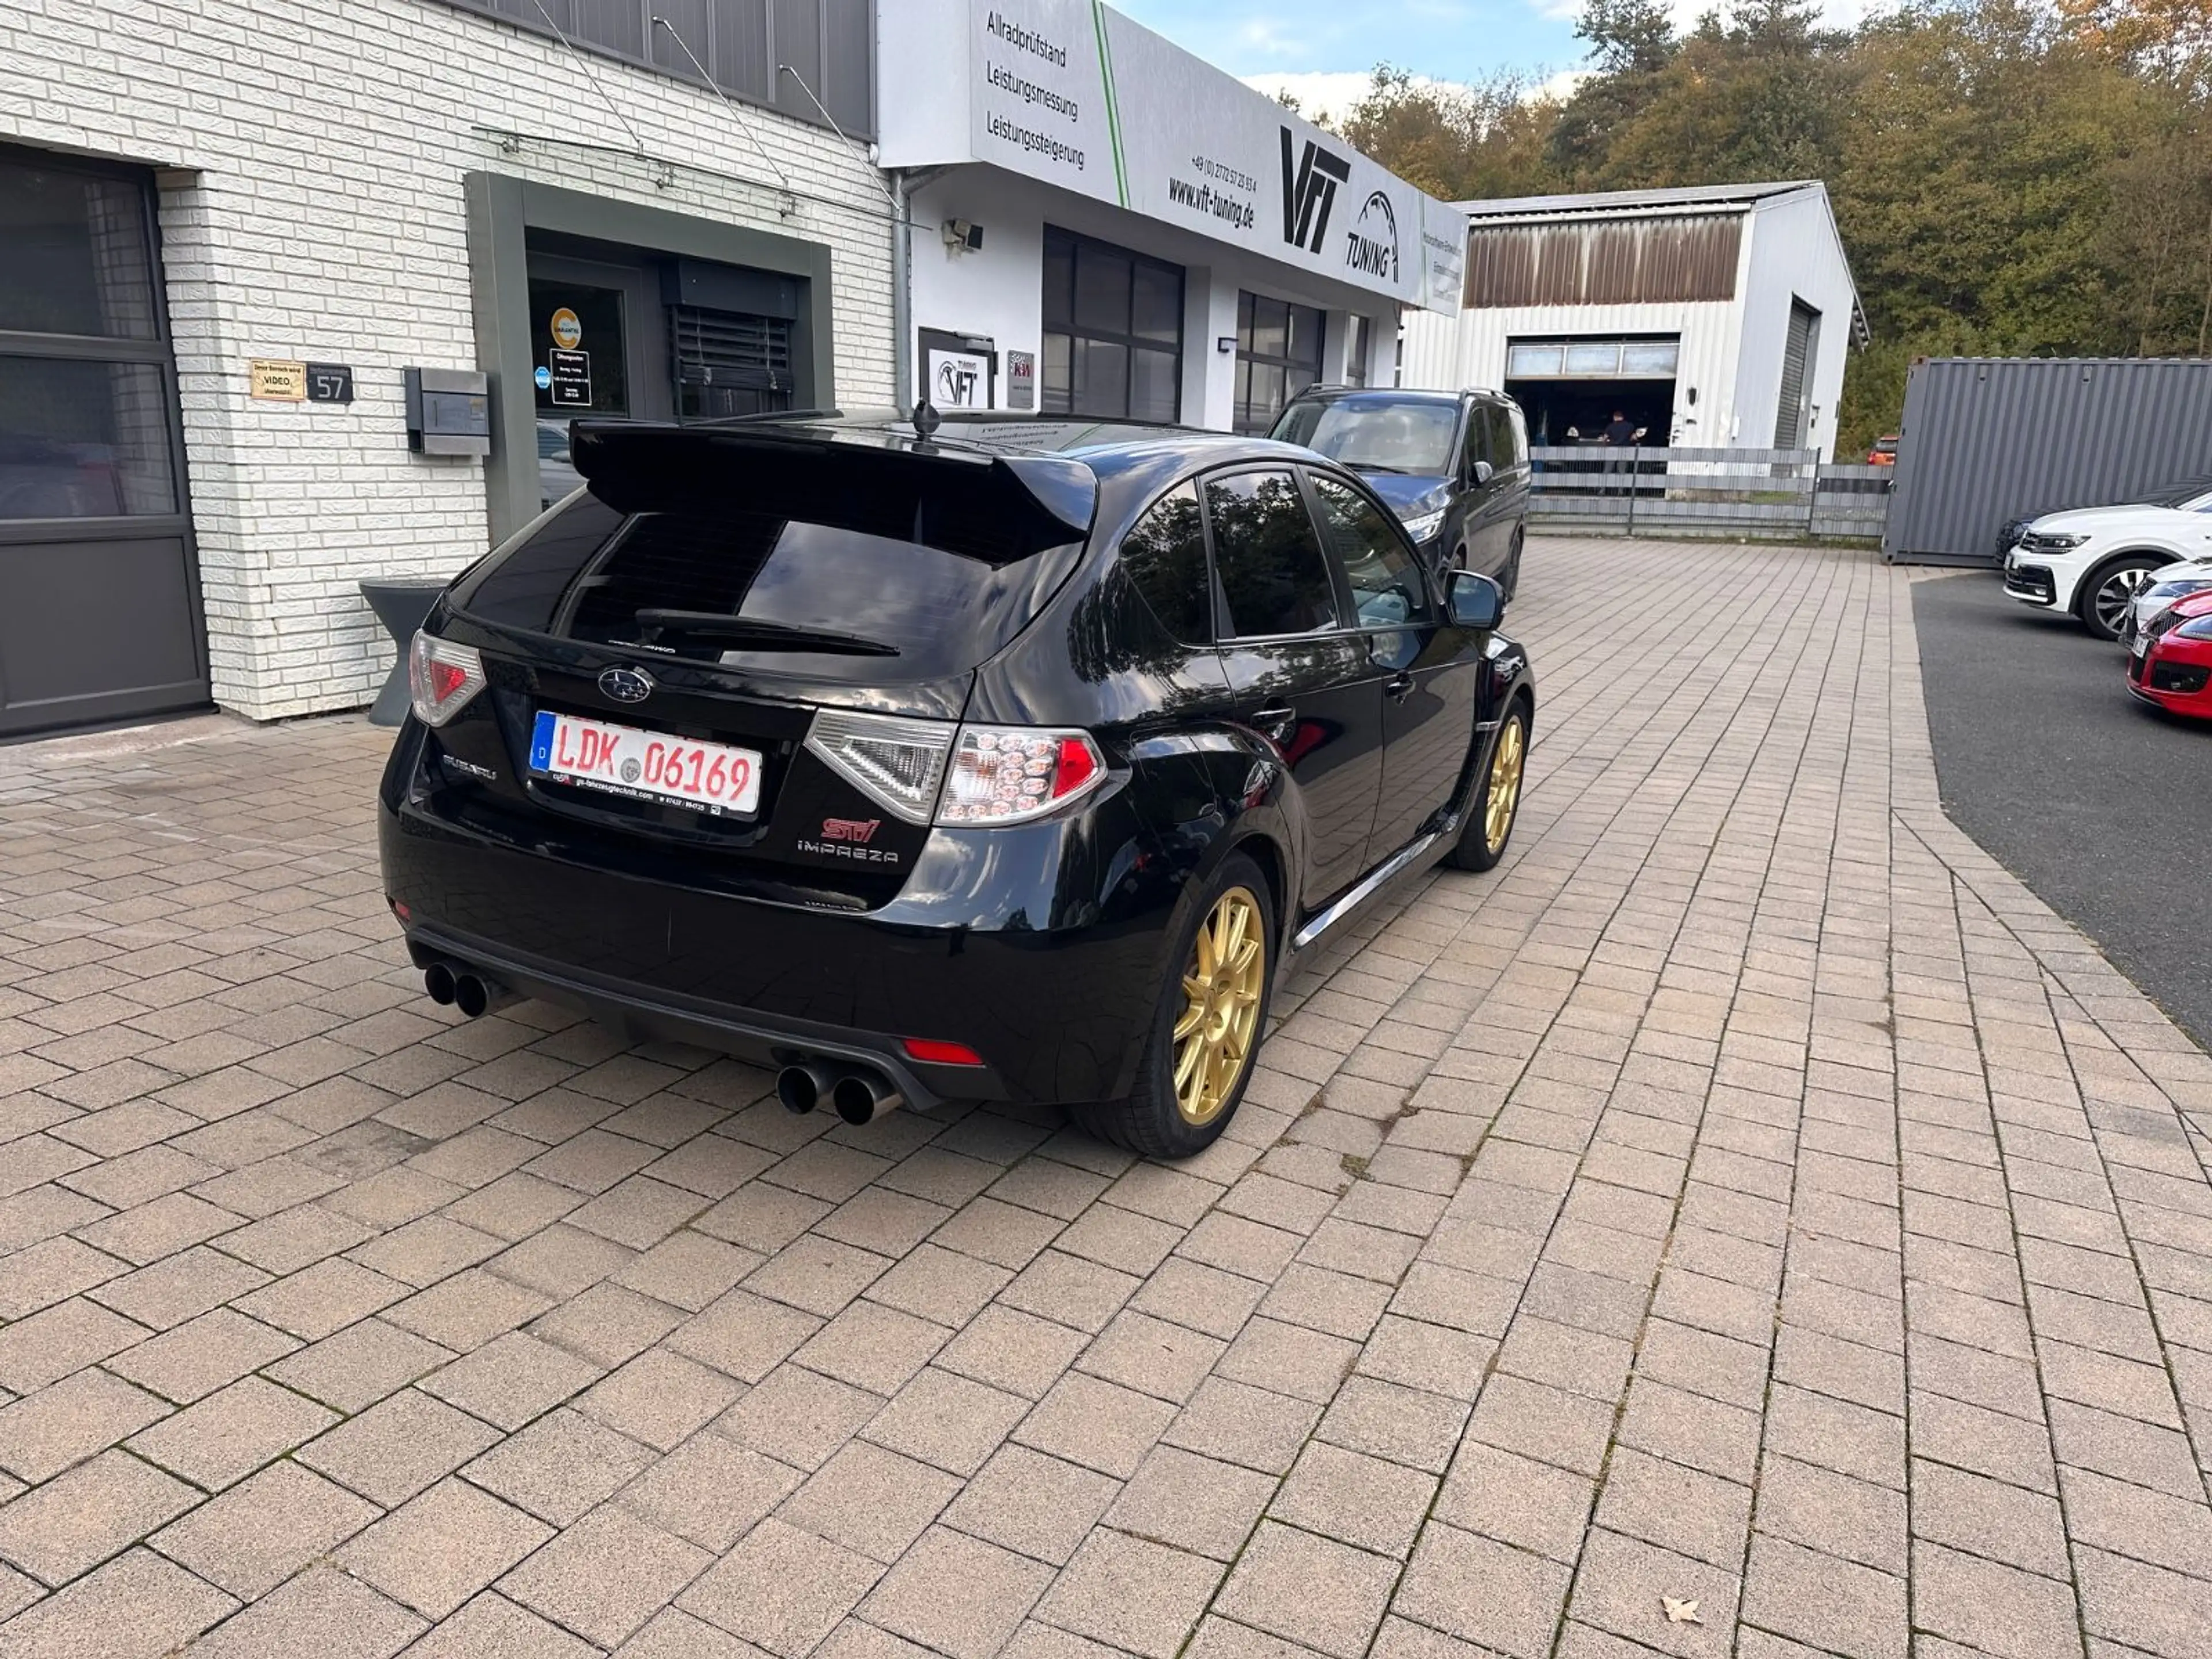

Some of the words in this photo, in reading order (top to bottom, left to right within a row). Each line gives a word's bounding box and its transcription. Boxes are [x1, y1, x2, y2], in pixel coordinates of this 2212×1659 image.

[987, 10, 1066, 68] Allradprüfstand
[987, 60, 1078, 123] Leistungsmessung
[987, 110, 1084, 171] Leistungssteigerung
[1169, 176, 1254, 230] www.vft-tuning.de
[1280, 124, 1351, 255] VFT
[1346, 231, 1389, 278] TUNING
[317, 375, 343, 399] 57
[539, 747, 546, 759] D
[556, 724, 621, 777] LDK
[643, 741, 751, 802] 06169
[797, 839, 899, 863] IMPREZA
